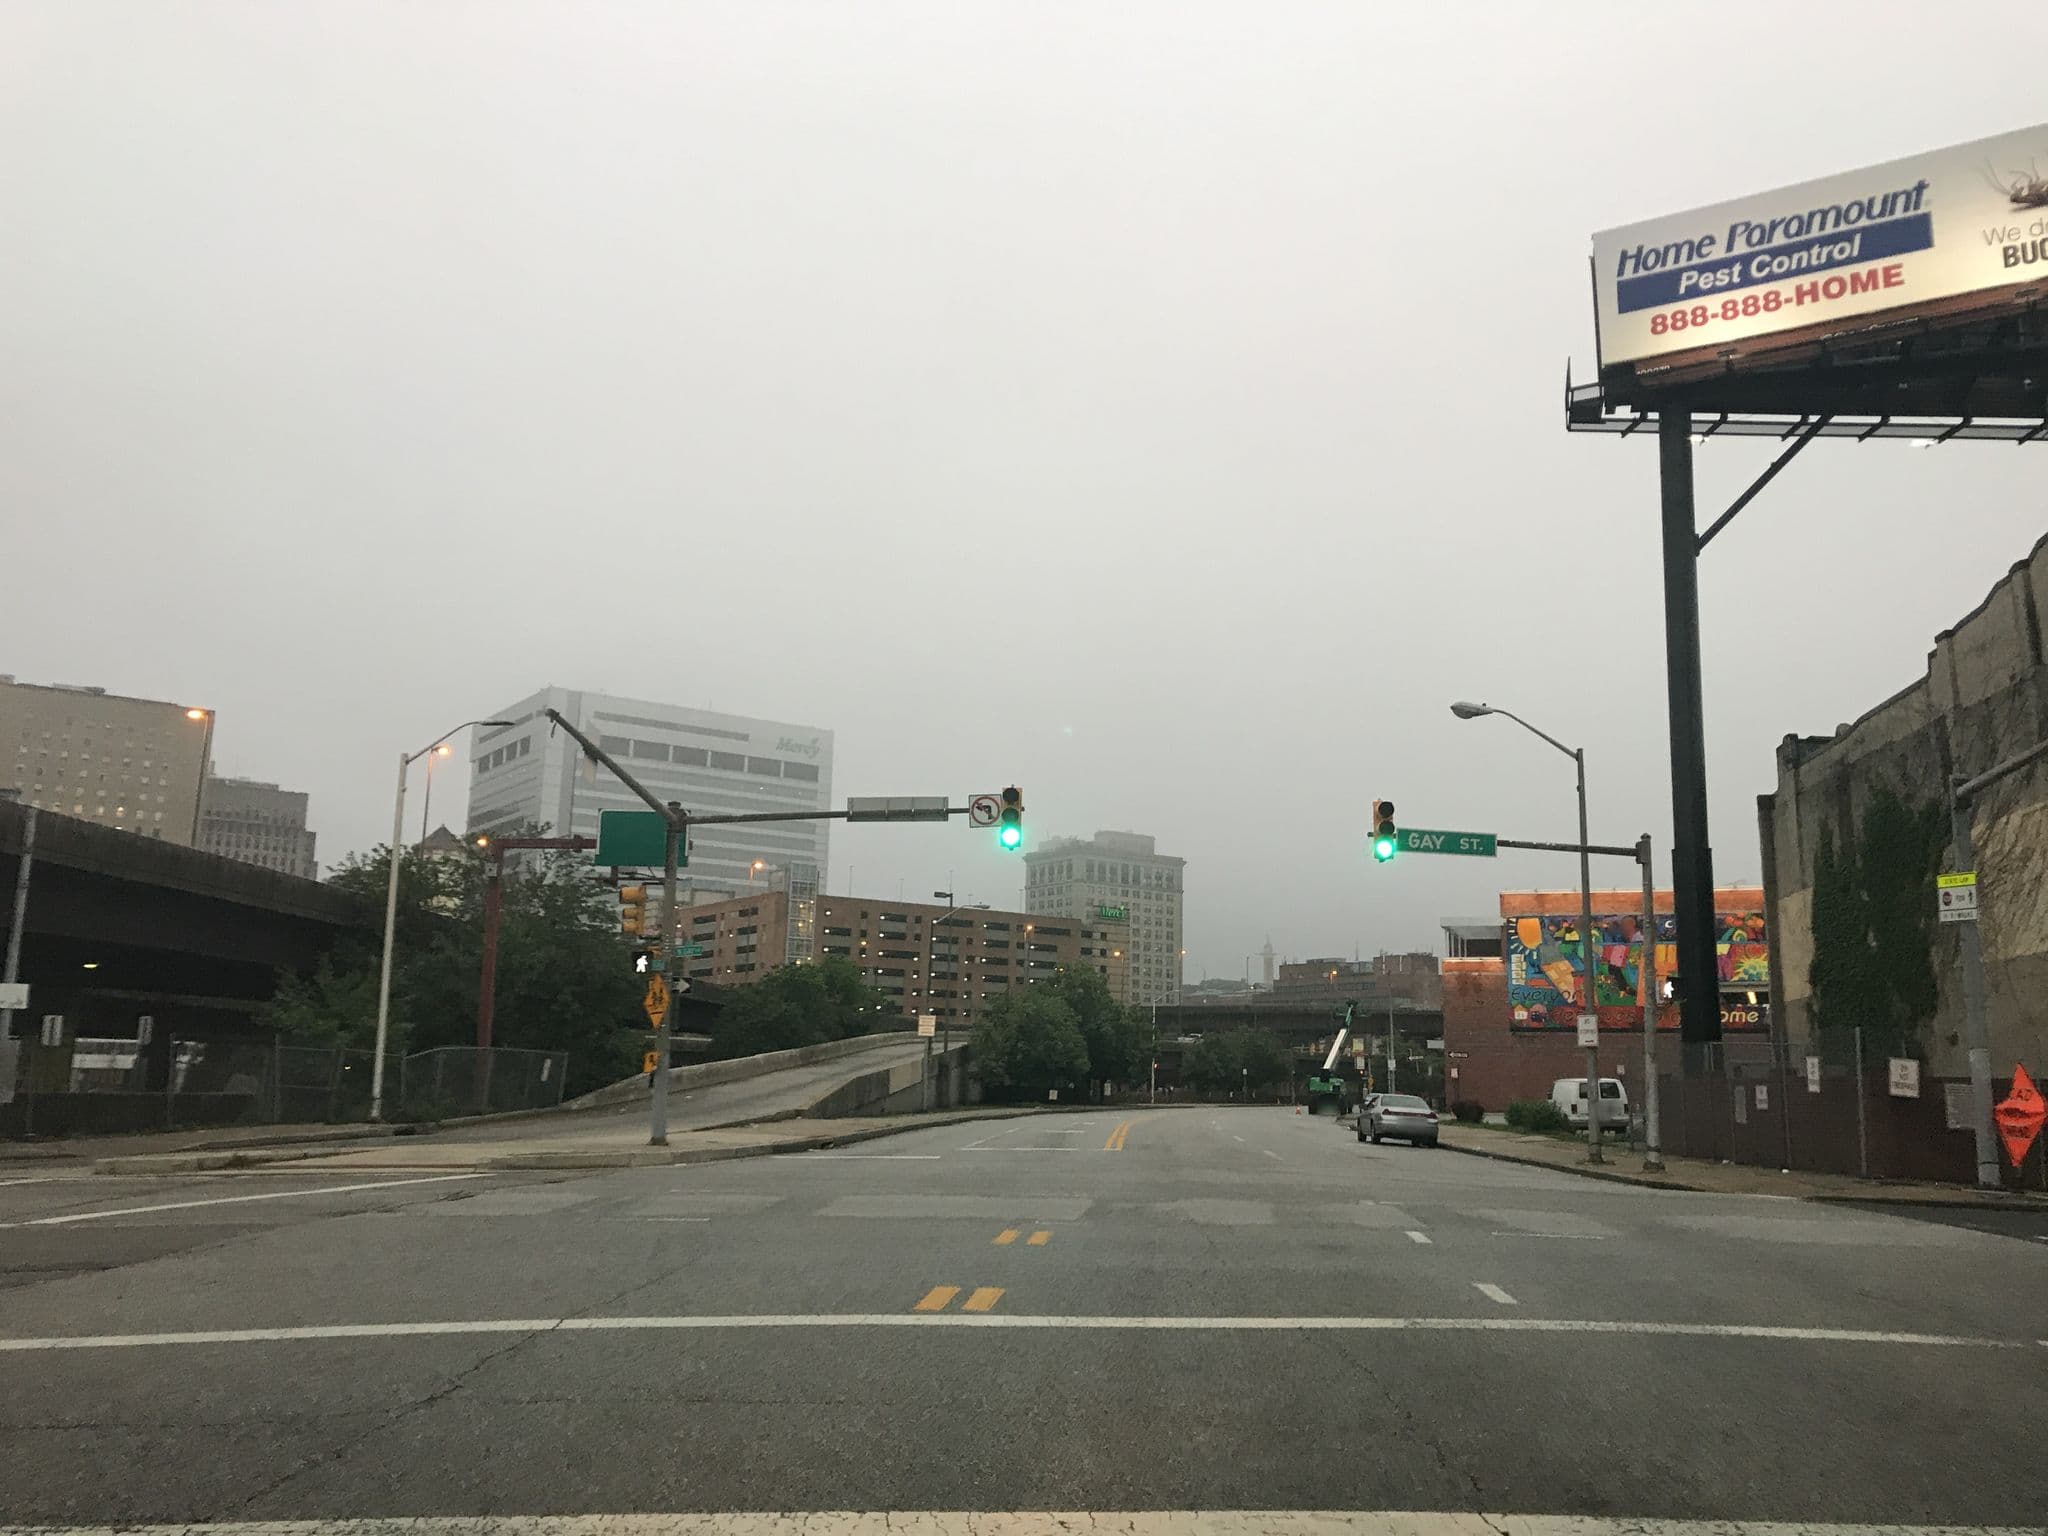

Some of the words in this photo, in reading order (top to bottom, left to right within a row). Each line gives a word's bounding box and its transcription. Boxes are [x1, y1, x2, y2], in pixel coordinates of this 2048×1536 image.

[1616, 233, 1716, 277] Home
[1727, 179, 1930, 253] Paramount
[1982, 226, 2021, 246] We
[2029, 217, 2048, 236] d
[1678, 262, 1742, 295] Pest
[1750, 233, 1862, 279] Control
[1650, 263, 1905, 335] 888-888-HOME
[1408, 832, 1445, 849] GAY
[1460, 838, 1484, 850] ST.
[1511, 986, 1585, 1001] Everyon
[1720, 1010, 1760, 1023] ome
